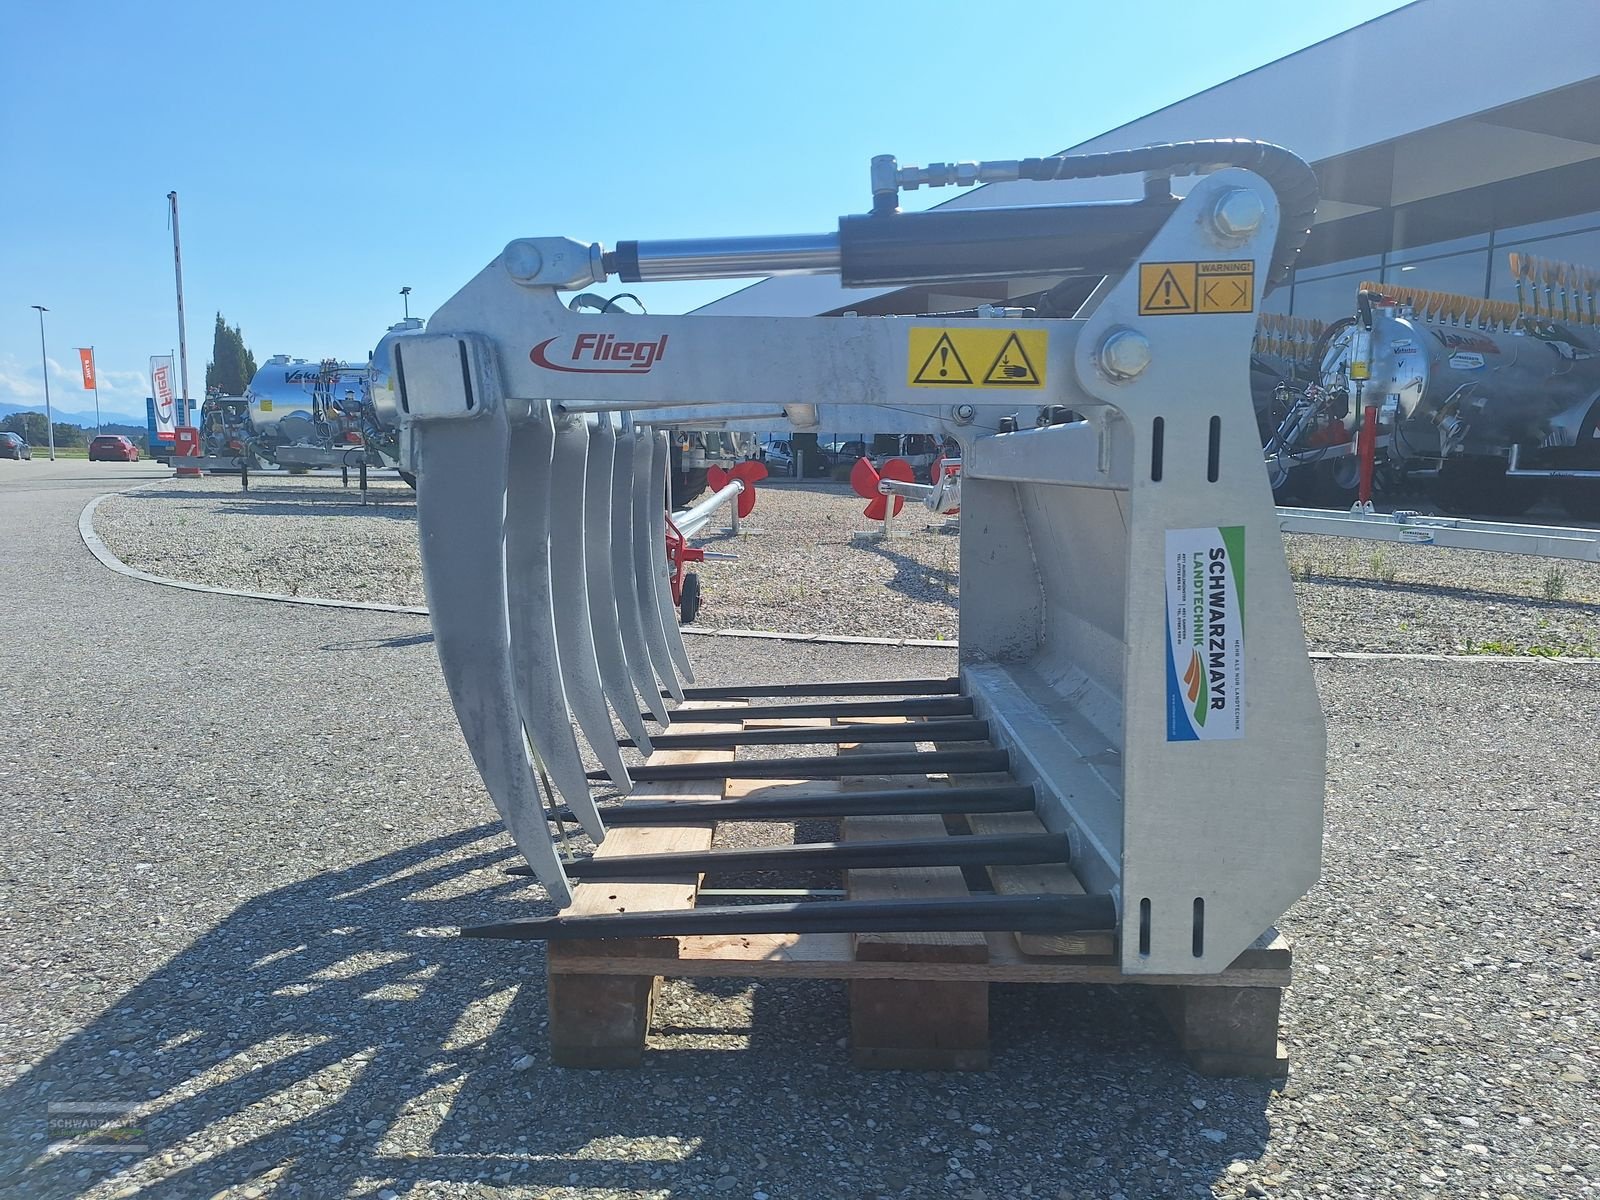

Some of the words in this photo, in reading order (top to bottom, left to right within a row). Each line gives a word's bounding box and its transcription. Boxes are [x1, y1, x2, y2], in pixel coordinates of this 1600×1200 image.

[1201, 262, 1251, 273] WARNING!
[571, 333, 669, 368] Fliegl
[1193, 552, 1204, 647] LANDTECHNIK
[1209, 547, 1226, 710] SCHWARZMAYR
